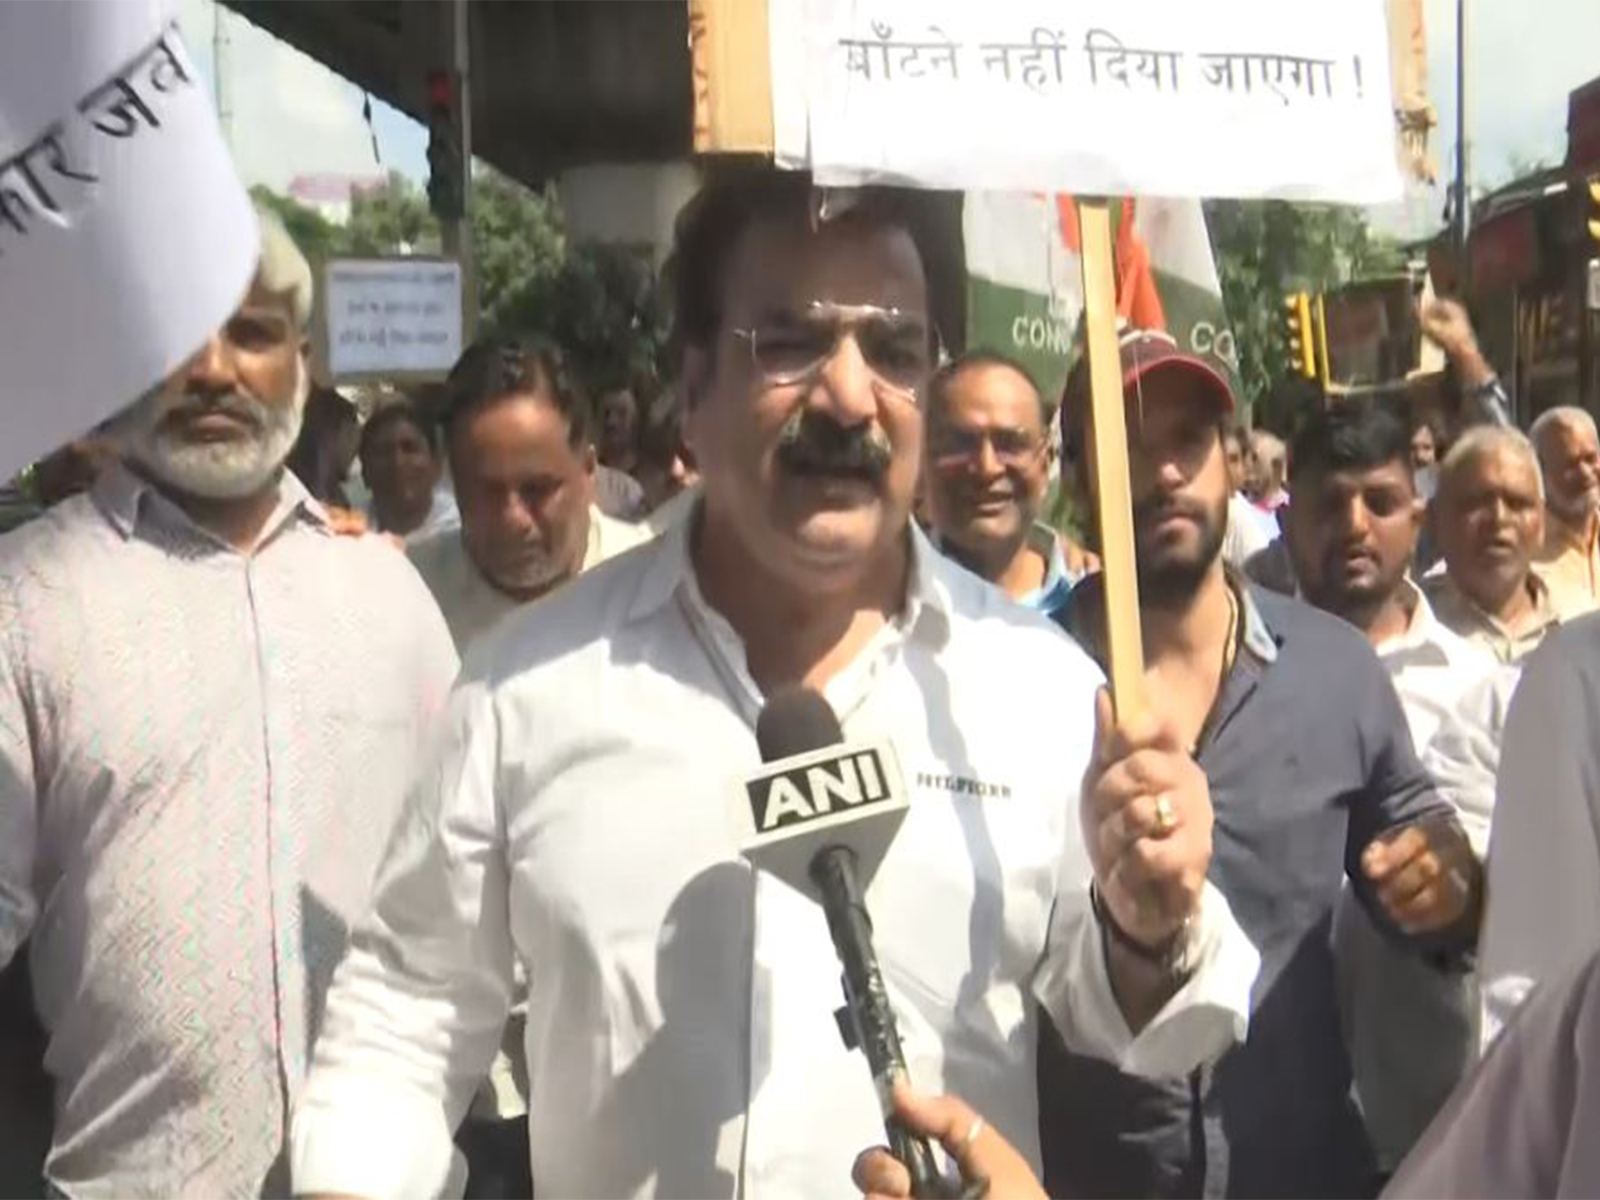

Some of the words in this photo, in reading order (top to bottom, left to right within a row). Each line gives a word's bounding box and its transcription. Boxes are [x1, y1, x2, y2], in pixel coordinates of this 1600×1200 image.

[979, 26, 1067, 96] नहीं
[1083, 27, 1184, 92] दिया
[1198, 52, 1337, 107] जाएगा
[761, 752, 884, 830] ANI
